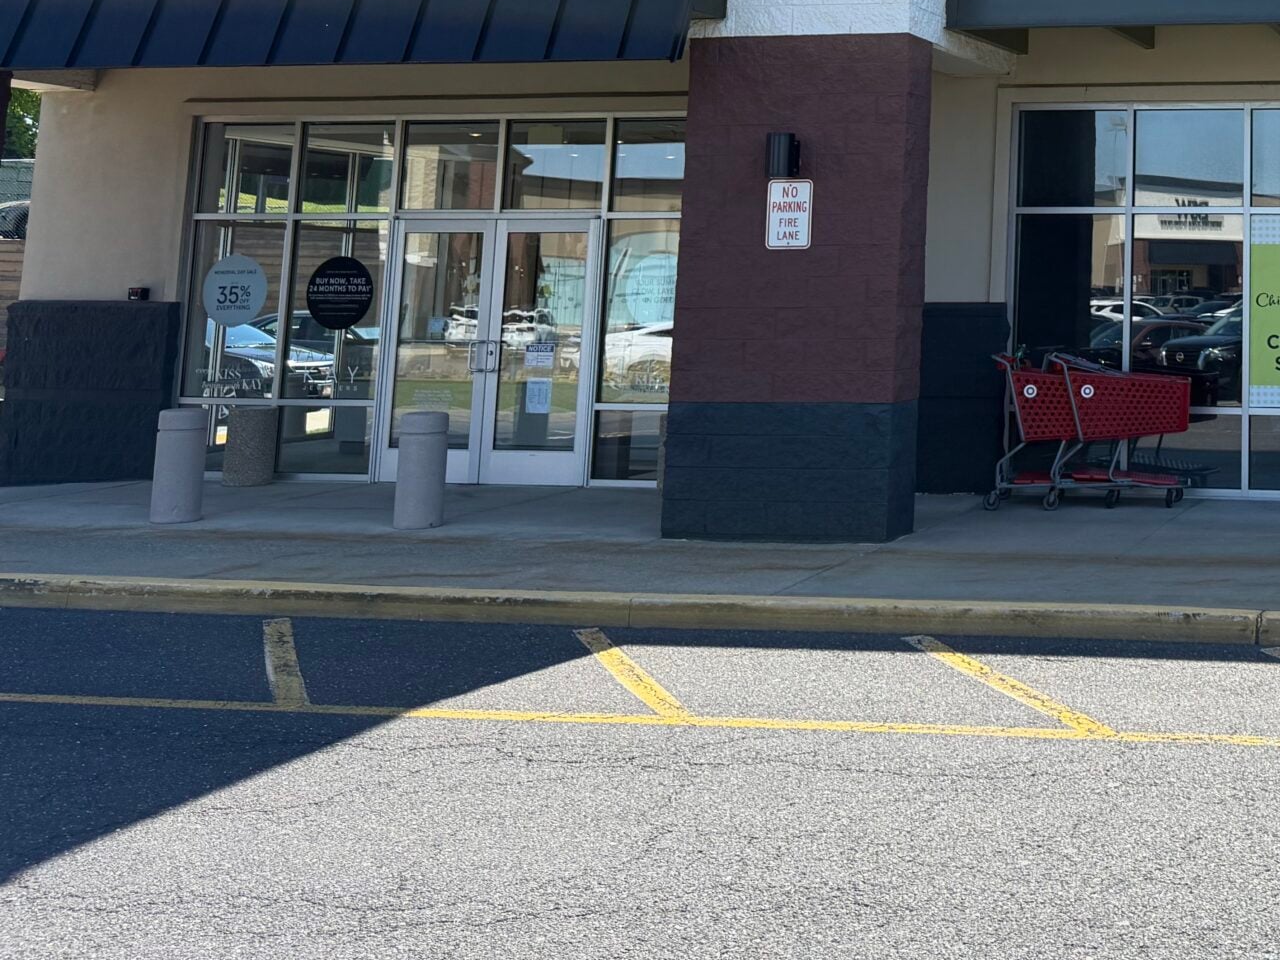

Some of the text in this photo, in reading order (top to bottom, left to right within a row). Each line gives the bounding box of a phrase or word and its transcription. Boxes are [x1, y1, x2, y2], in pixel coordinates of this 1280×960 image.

[782, 186, 798, 198] NO
[772, 201, 807, 213] PARKING
[779, 218, 799, 228] FIRE
[777, 231, 800, 241] LANE
[315, 277, 367, 285] BUY NOW, TAKE
[216, 285, 251, 304] 35%
[215, 368, 242, 380] KISS
[303, 366, 359, 384] KAY
[242, 379, 263, 390] KAY
